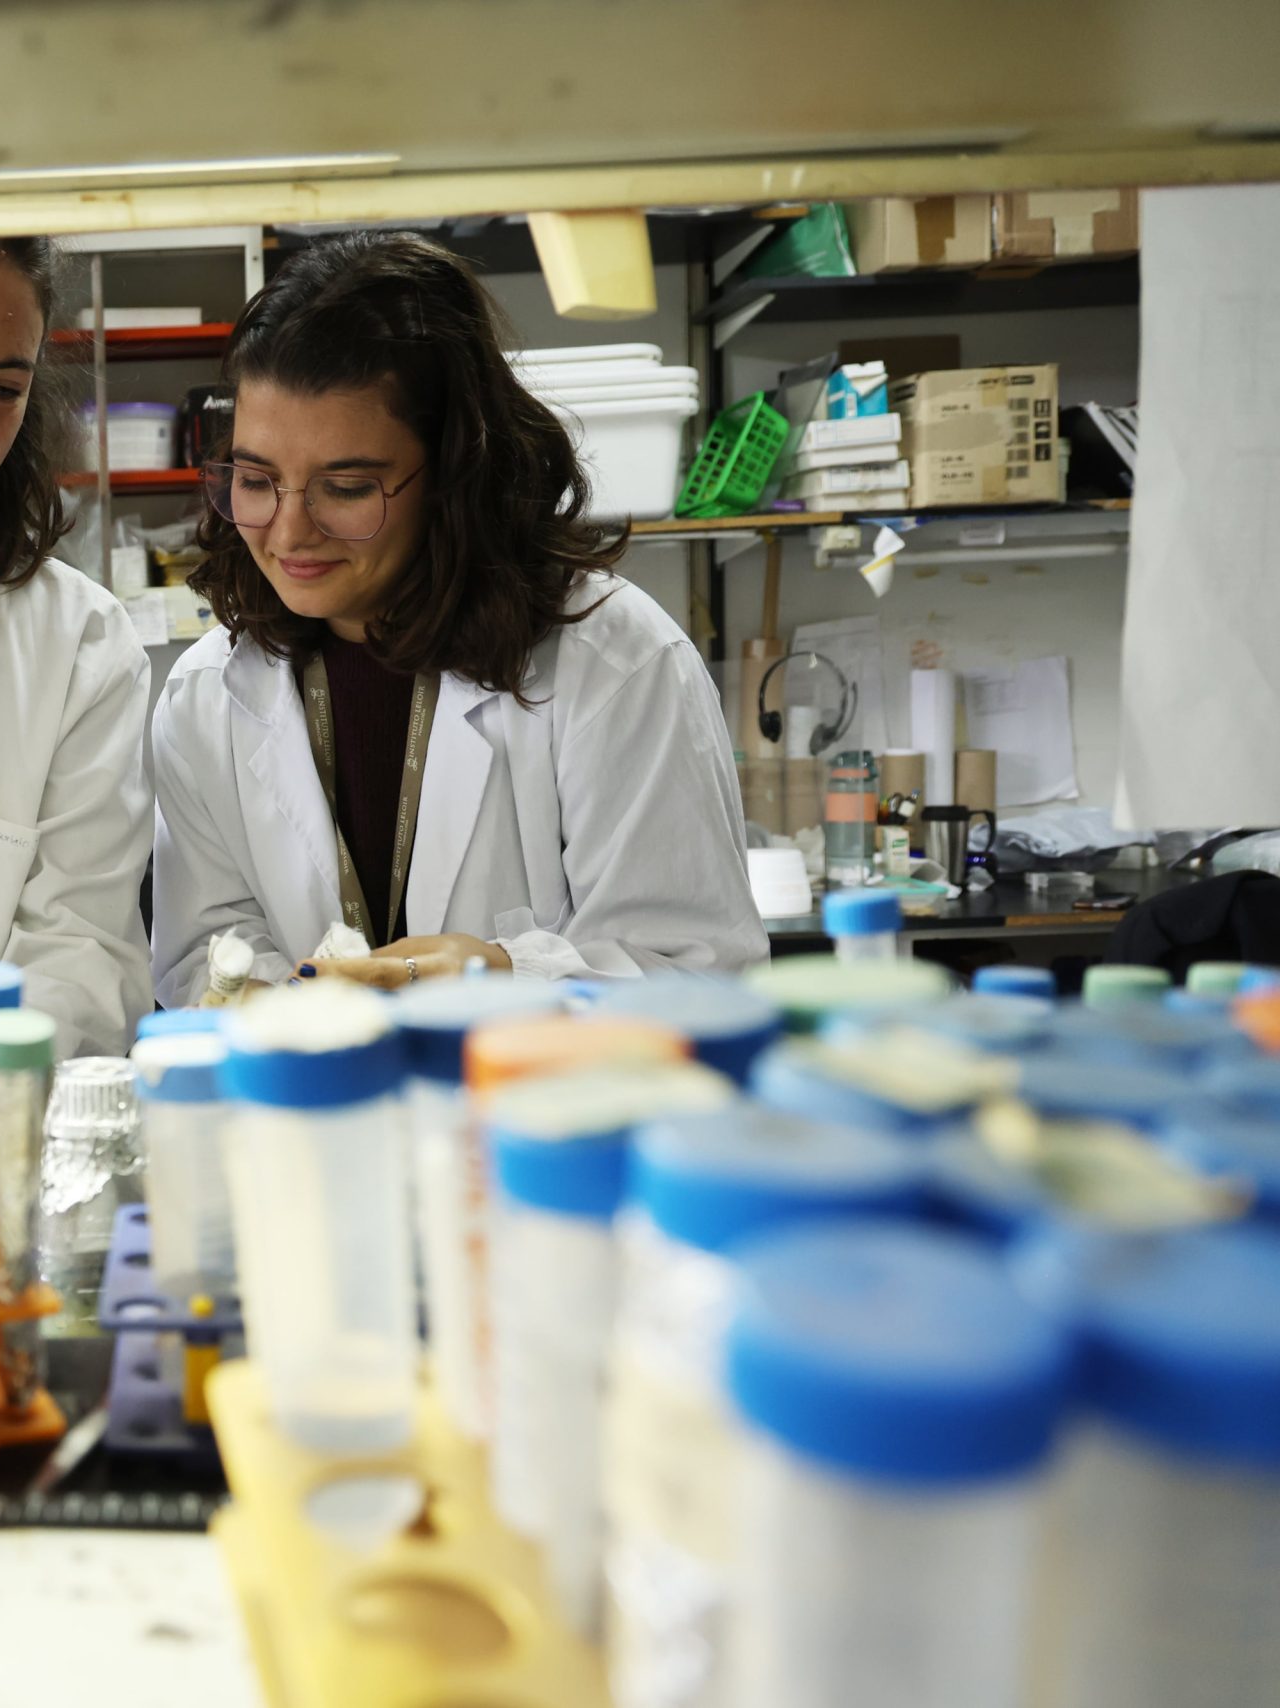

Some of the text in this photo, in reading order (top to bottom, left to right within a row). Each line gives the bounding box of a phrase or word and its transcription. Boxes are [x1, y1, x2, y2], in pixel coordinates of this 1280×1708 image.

[318, 697, 332, 767] INSTITUTO LELOIR
[409, 685, 426, 758] INSTITUTO LELOIR
[395, 796, 408, 868] INSTITUTO LELOIR
